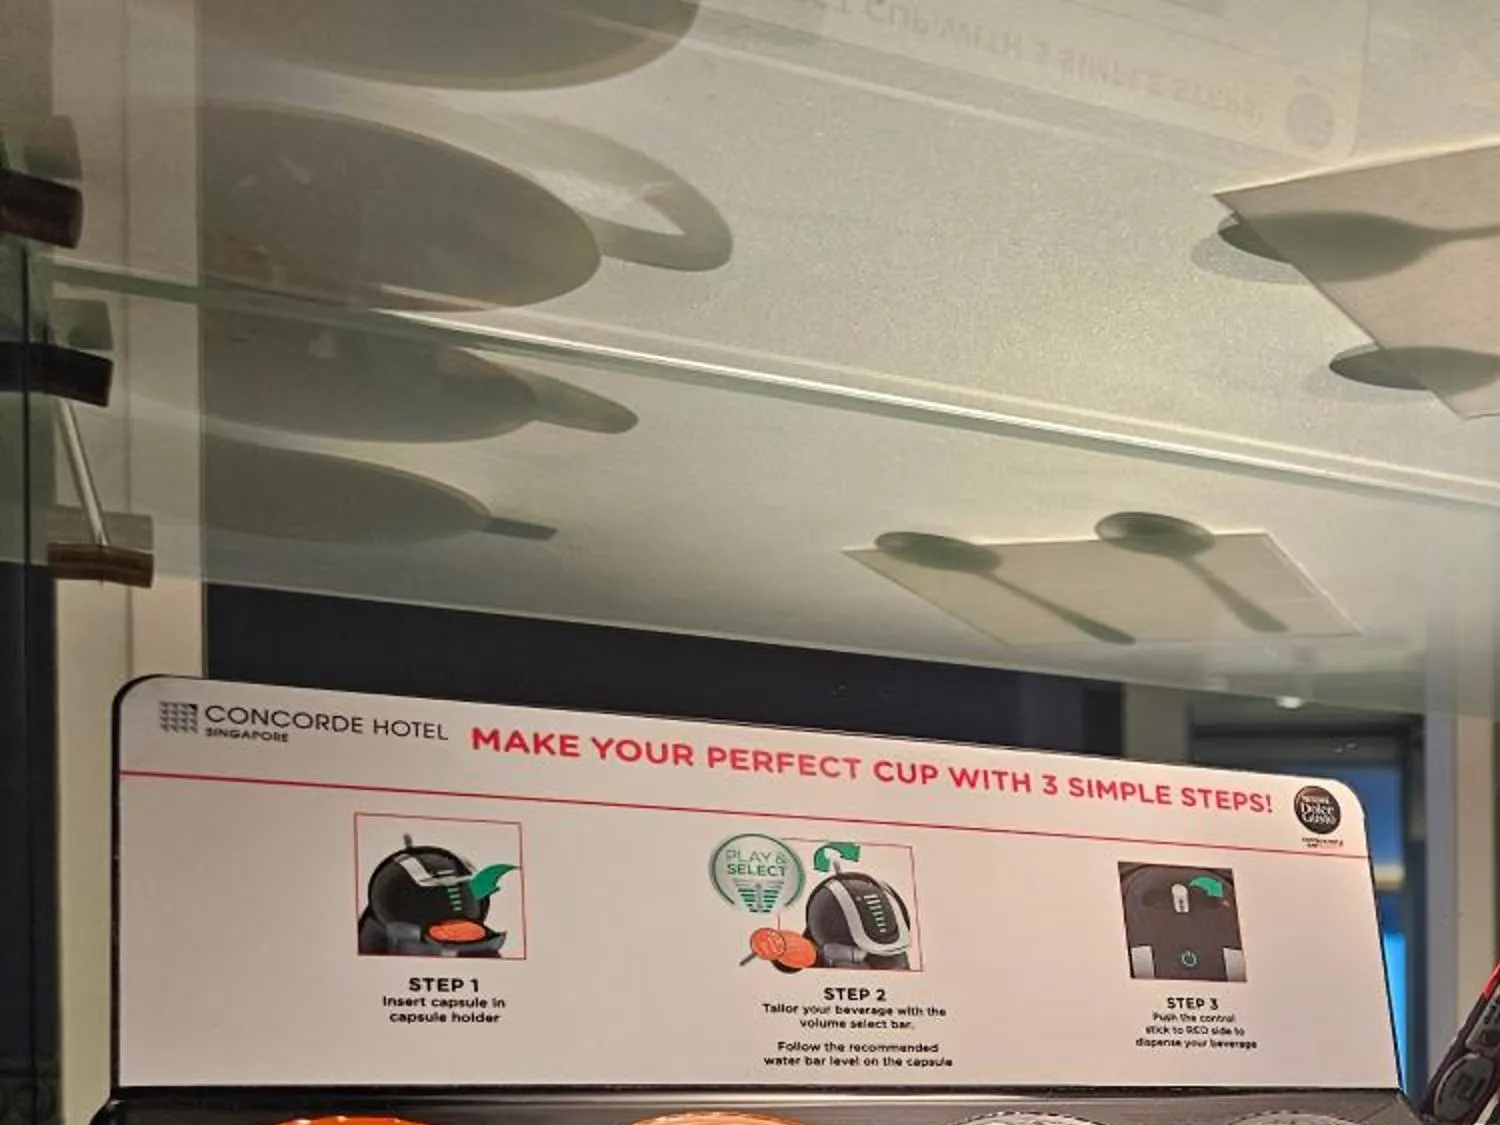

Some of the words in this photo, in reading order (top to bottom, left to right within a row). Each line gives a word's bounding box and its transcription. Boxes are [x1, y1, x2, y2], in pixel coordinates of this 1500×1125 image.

[205, 705, 363, 734] CONCORDE
[372, 719, 449, 741] HOTEL
[205, 727, 289, 743] SINGAPORE
[471, 727, 581, 758] MAKE
[591, 736, 694, 767] YOUR
[707, 745, 862, 780] PERFECT
[873, 761, 938, 785] CUP
[948, 766, 1031, 793] WITH
[1041, 774, 1057, 796] 3
[1069, 776, 1173, 806] SIMPLE
[1181, 786, 1274, 813] STEPS!
[726, 849, 771, 862] PLAY
[728, 863, 785, 877] SELECT
[409, 977, 464, 992] STEP
[470, 978, 478, 993] 1
[824, 987, 870, 1001] STEP
[876, 988, 887, 1001] 2
[383, 995, 426, 1006] Insert
[431, 997, 487, 1008] capsule
[492, 998, 505, 1008] in
[1167, 997, 1205, 1009] STEP
[1210, 998, 1219, 1010] 3
[763, 1003, 798, 1013] Tailor
[802, 1005, 830, 1016] your
[835, 1005, 893, 1016] beverage
[897, 1006, 923, 1016] with
[928, 1006, 947, 1017] the
[389, 1011, 446, 1024] capsule
[451, 1011, 500, 1022] holder
[800, 1018, 846, 1028] volume
[850, 1018, 887, 1029] select
[1180, 1013, 1197, 1022] the
[777, 1041, 821, 1051] Follow
[824, 1041, 845, 1052] the
[850, 1042, 939, 1053] recommended
[763, 1057, 800, 1066] water
[805, 1056, 826, 1066] bar
[830, 1056, 859, 1066] level
[863, 1058, 879, 1067] on
[884, 1056, 903, 1067] the
[906, 1056, 953, 1068] capsule
